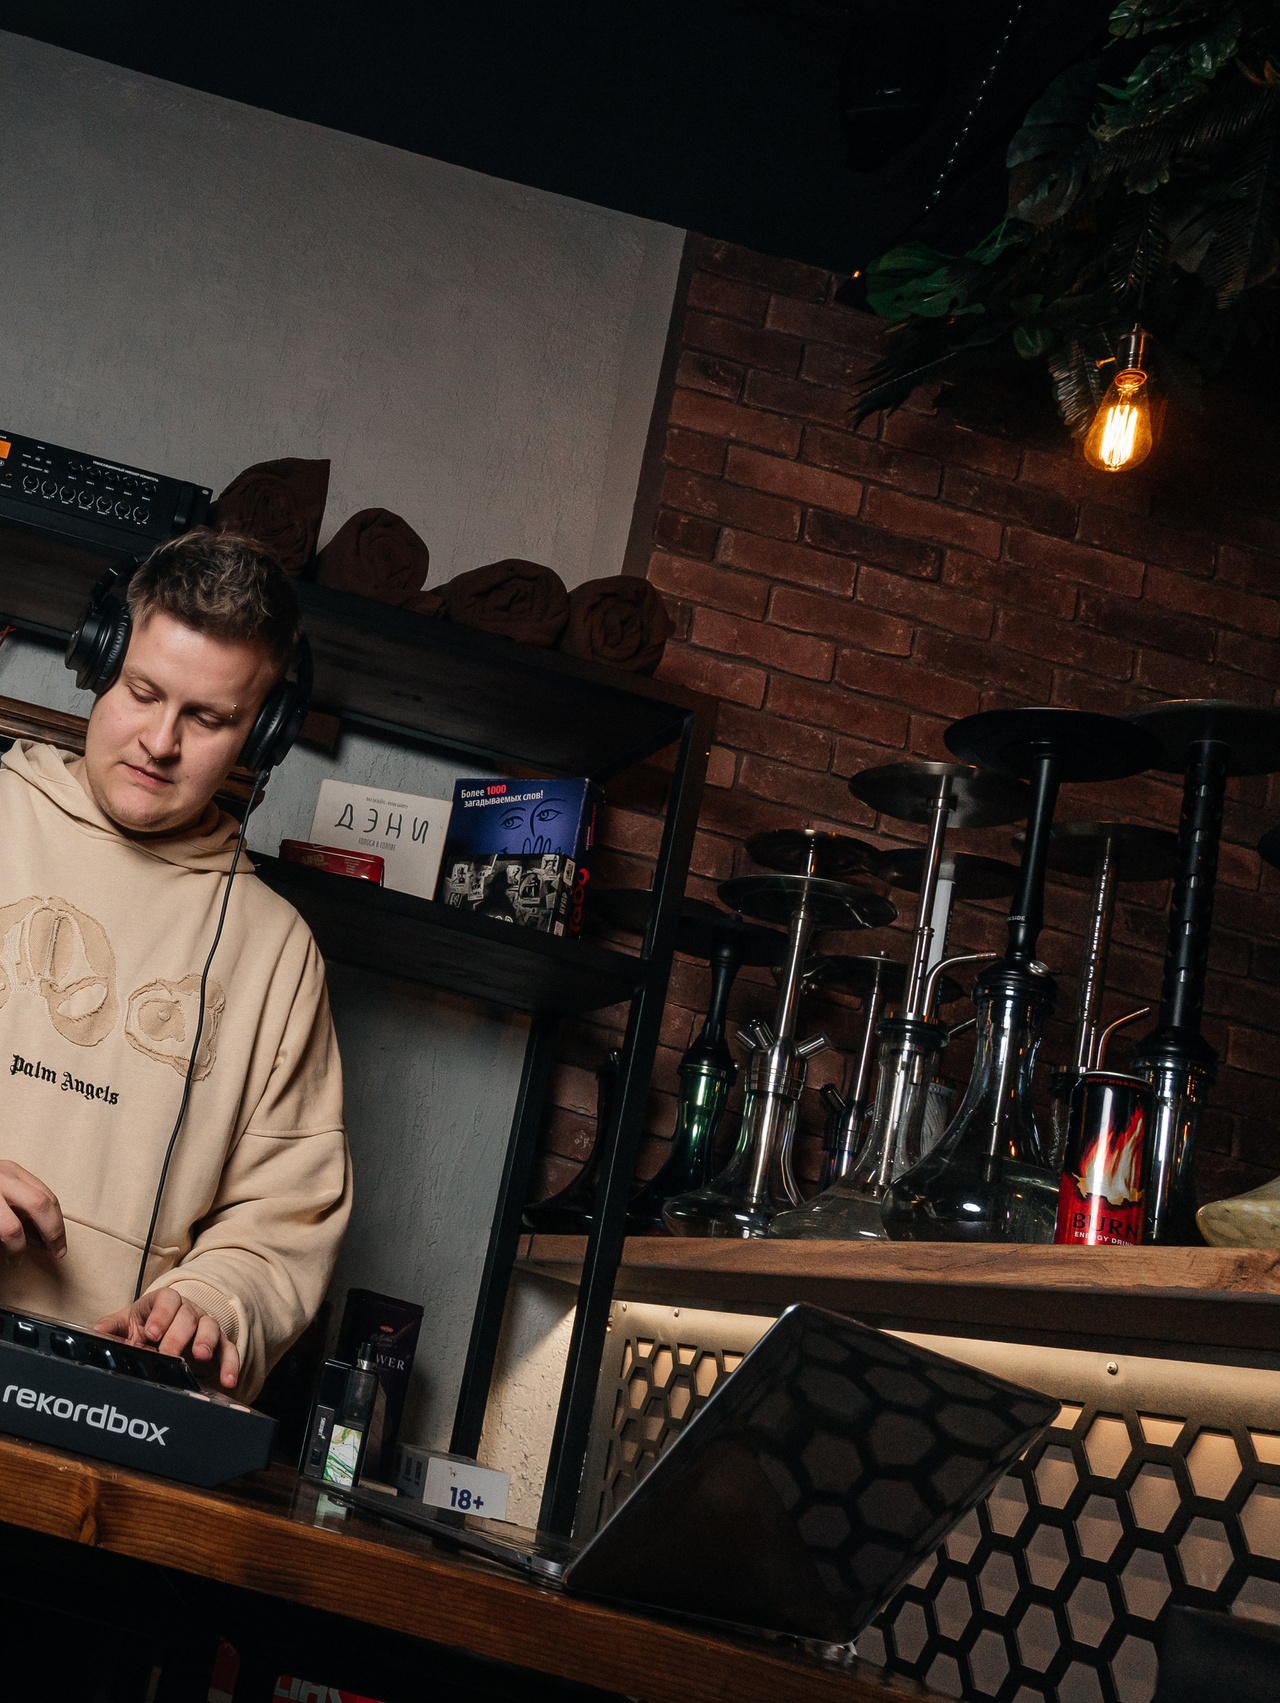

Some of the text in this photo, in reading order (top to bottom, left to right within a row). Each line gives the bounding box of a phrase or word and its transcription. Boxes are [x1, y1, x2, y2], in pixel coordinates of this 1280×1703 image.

[461, 784, 507, 799] Более 1000
[463, 789, 544, 808] загадываемых слов!
[334, 803, 430, 844] ДЭНИ
[10, 1054, 120, 1106] Palm Angels
[1072, 1211, 1140, 1240] BURN
[1074, 1231, 1110, 1243] ENEGY
[2, 1383, 170, 1447] rekordbox
[449, 1486, 484, 1511] 18+
